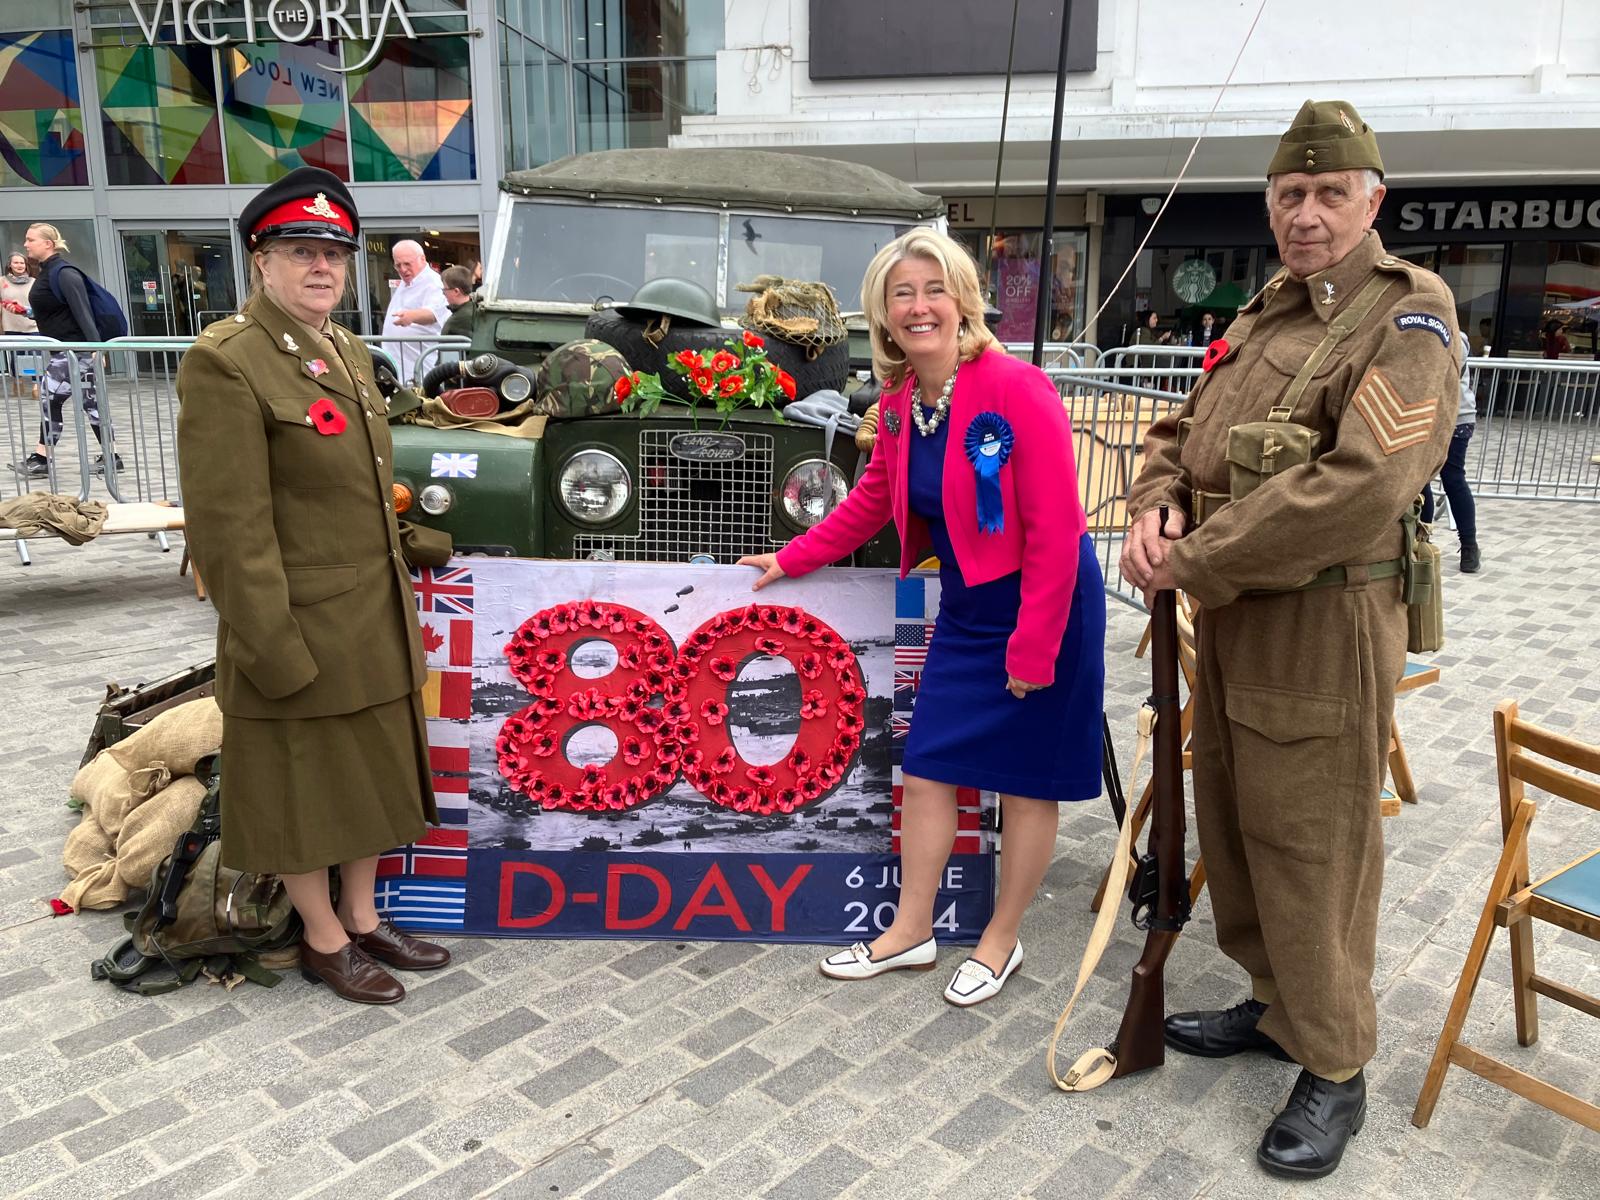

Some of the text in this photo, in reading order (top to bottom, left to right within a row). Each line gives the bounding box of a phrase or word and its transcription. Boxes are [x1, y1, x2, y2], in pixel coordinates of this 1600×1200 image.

[275, 9, 306, 23] THE
[128, 0, 417, 73] VICTORIA
[1006, 275, 1032, 286] 20%
[1005, 286, 1032, 298] OFF
[1400, 315, 1428, 326] ROYAL
[682, 437, 714, 446] LAND
[698, 448, 735, 459] ROVER
[495, 599, 868, 816] 80
[845, 865, 964, 889] 6 JUE
[497, 861, 815, 932] D-DAY
[843, 900, 960, 932] 204
